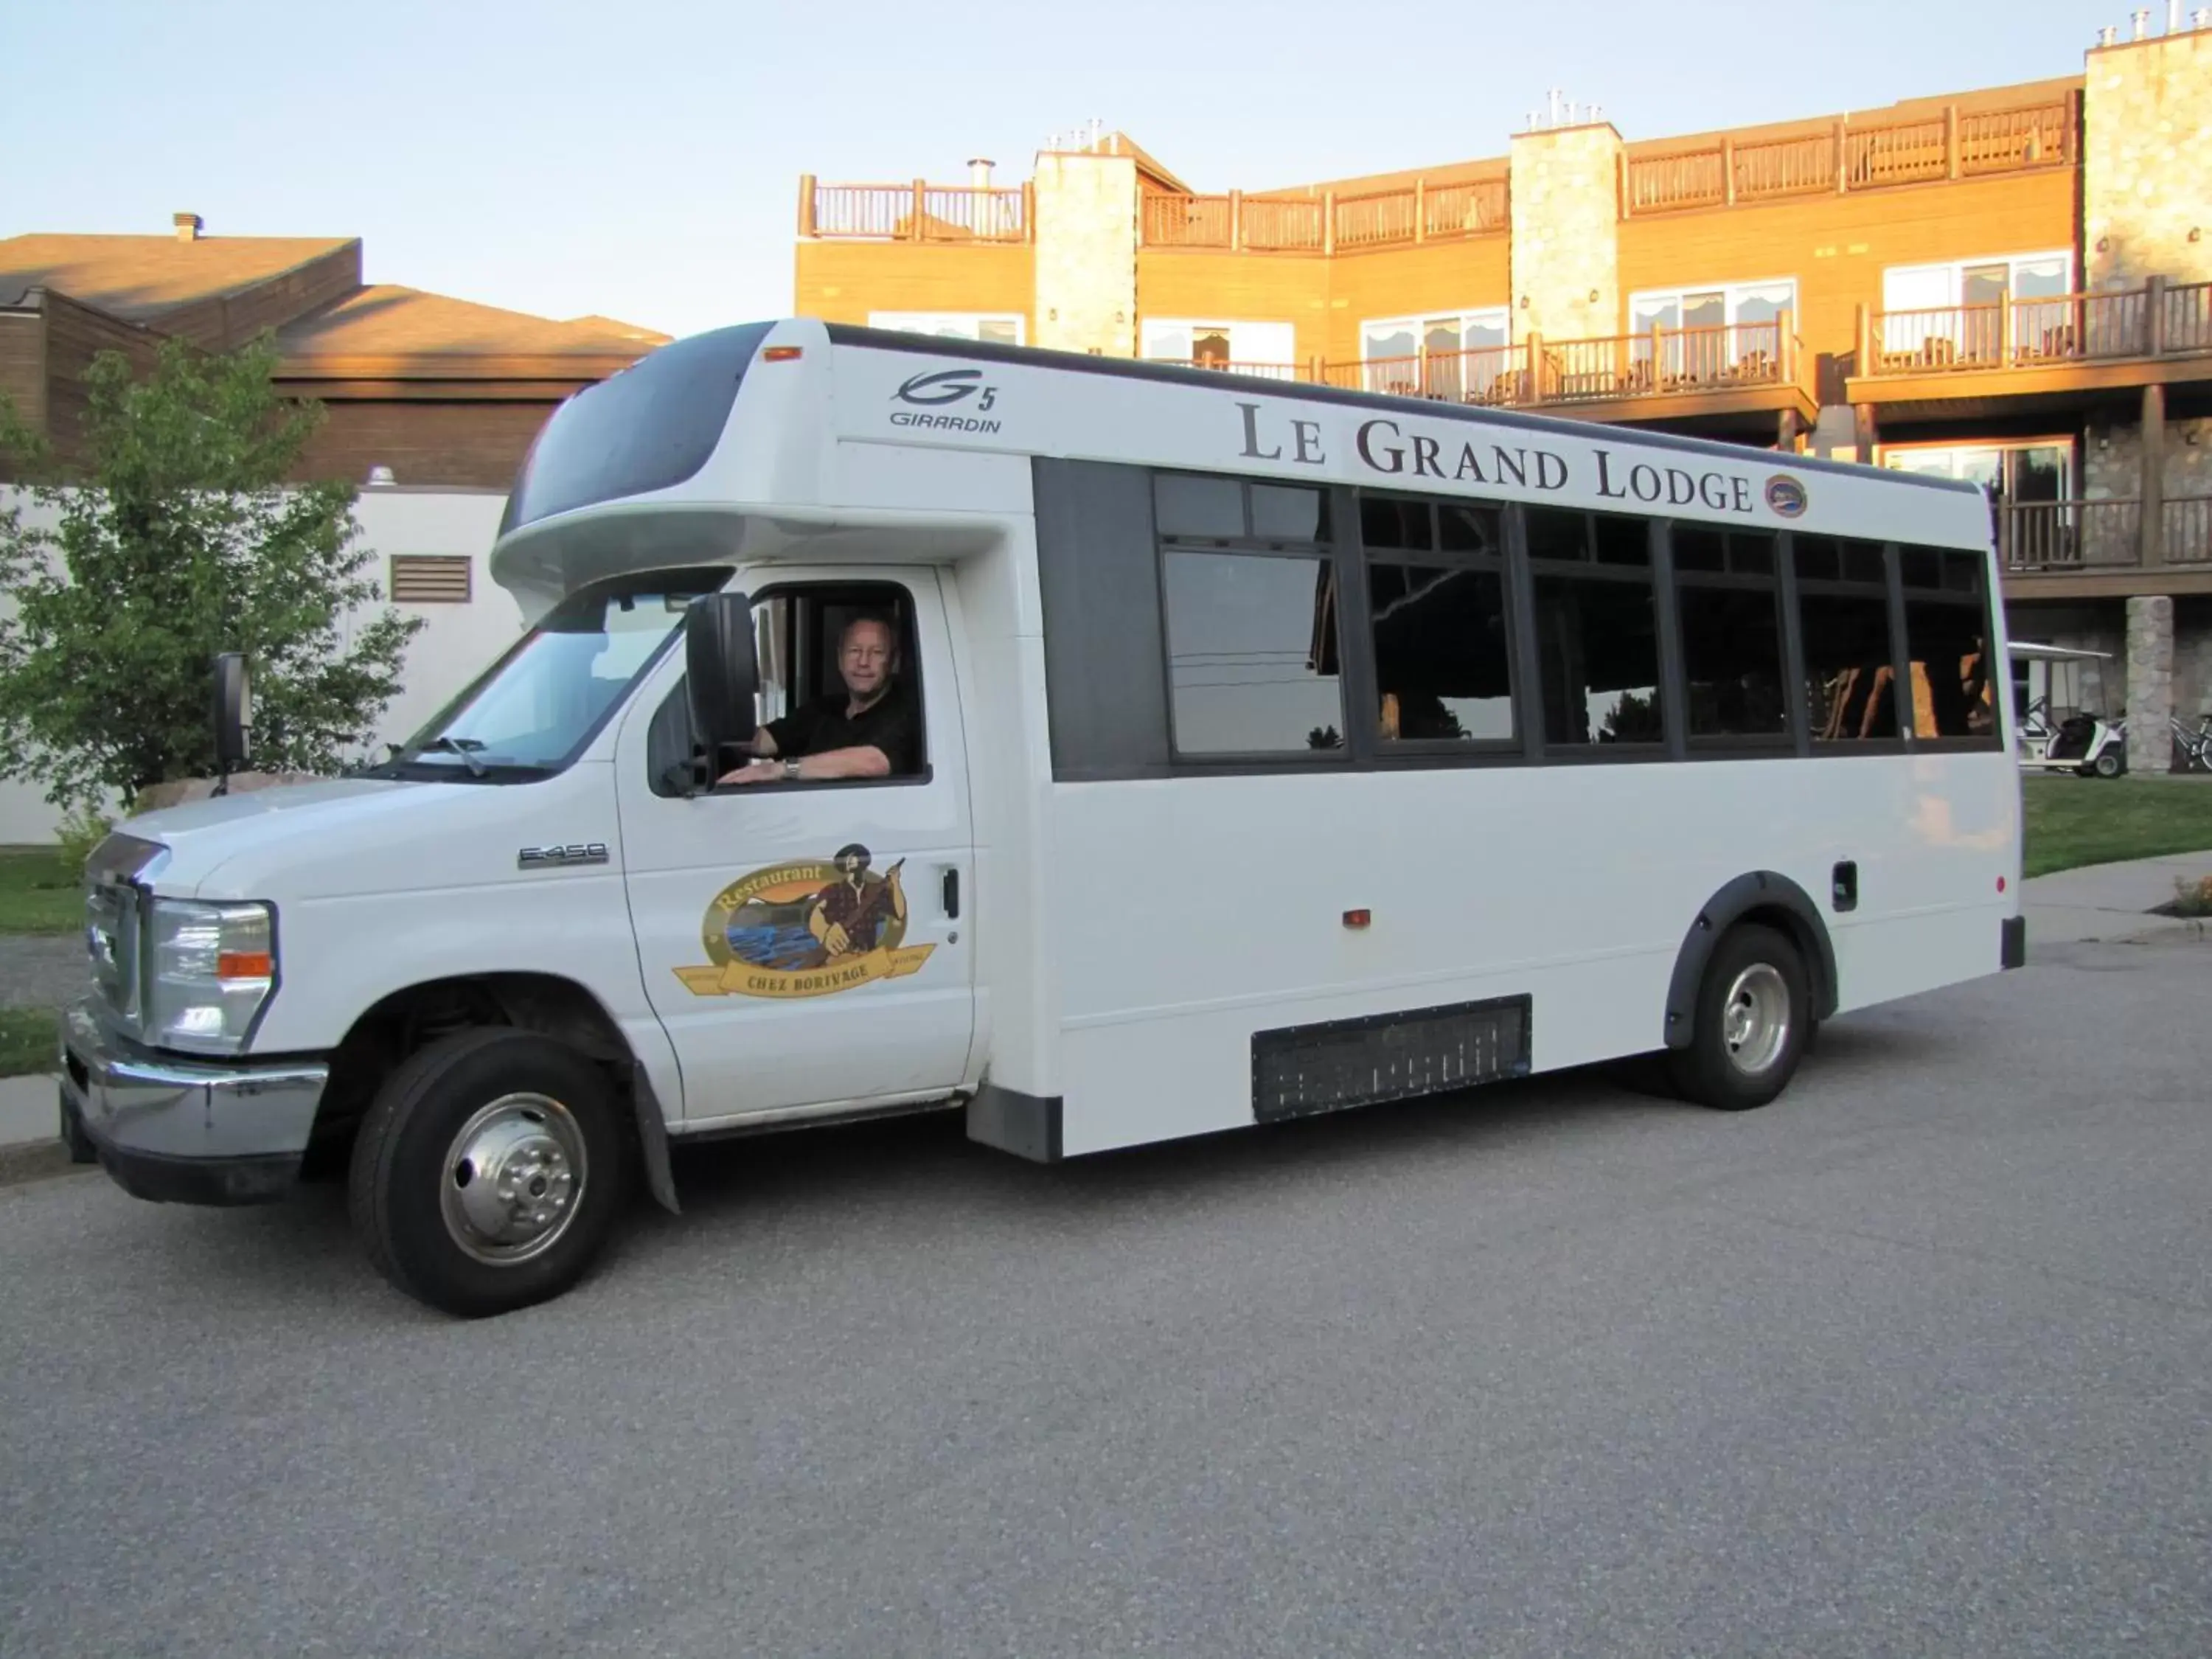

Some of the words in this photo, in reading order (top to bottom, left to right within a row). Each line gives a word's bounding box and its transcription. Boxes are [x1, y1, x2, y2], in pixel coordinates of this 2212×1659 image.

[889, 412, 1001, 434] GIRARDIN
[1235, 403, 1326, 465] LE
[1357, 419, 1568, 491] GRAND
[1593, 450, 1754, 513] LODGE
[717, 864, 822, 913] Restaurant
[747, 975, 787, 992] CHEZ
[794, 964, 869, 992] BORIVAGE
